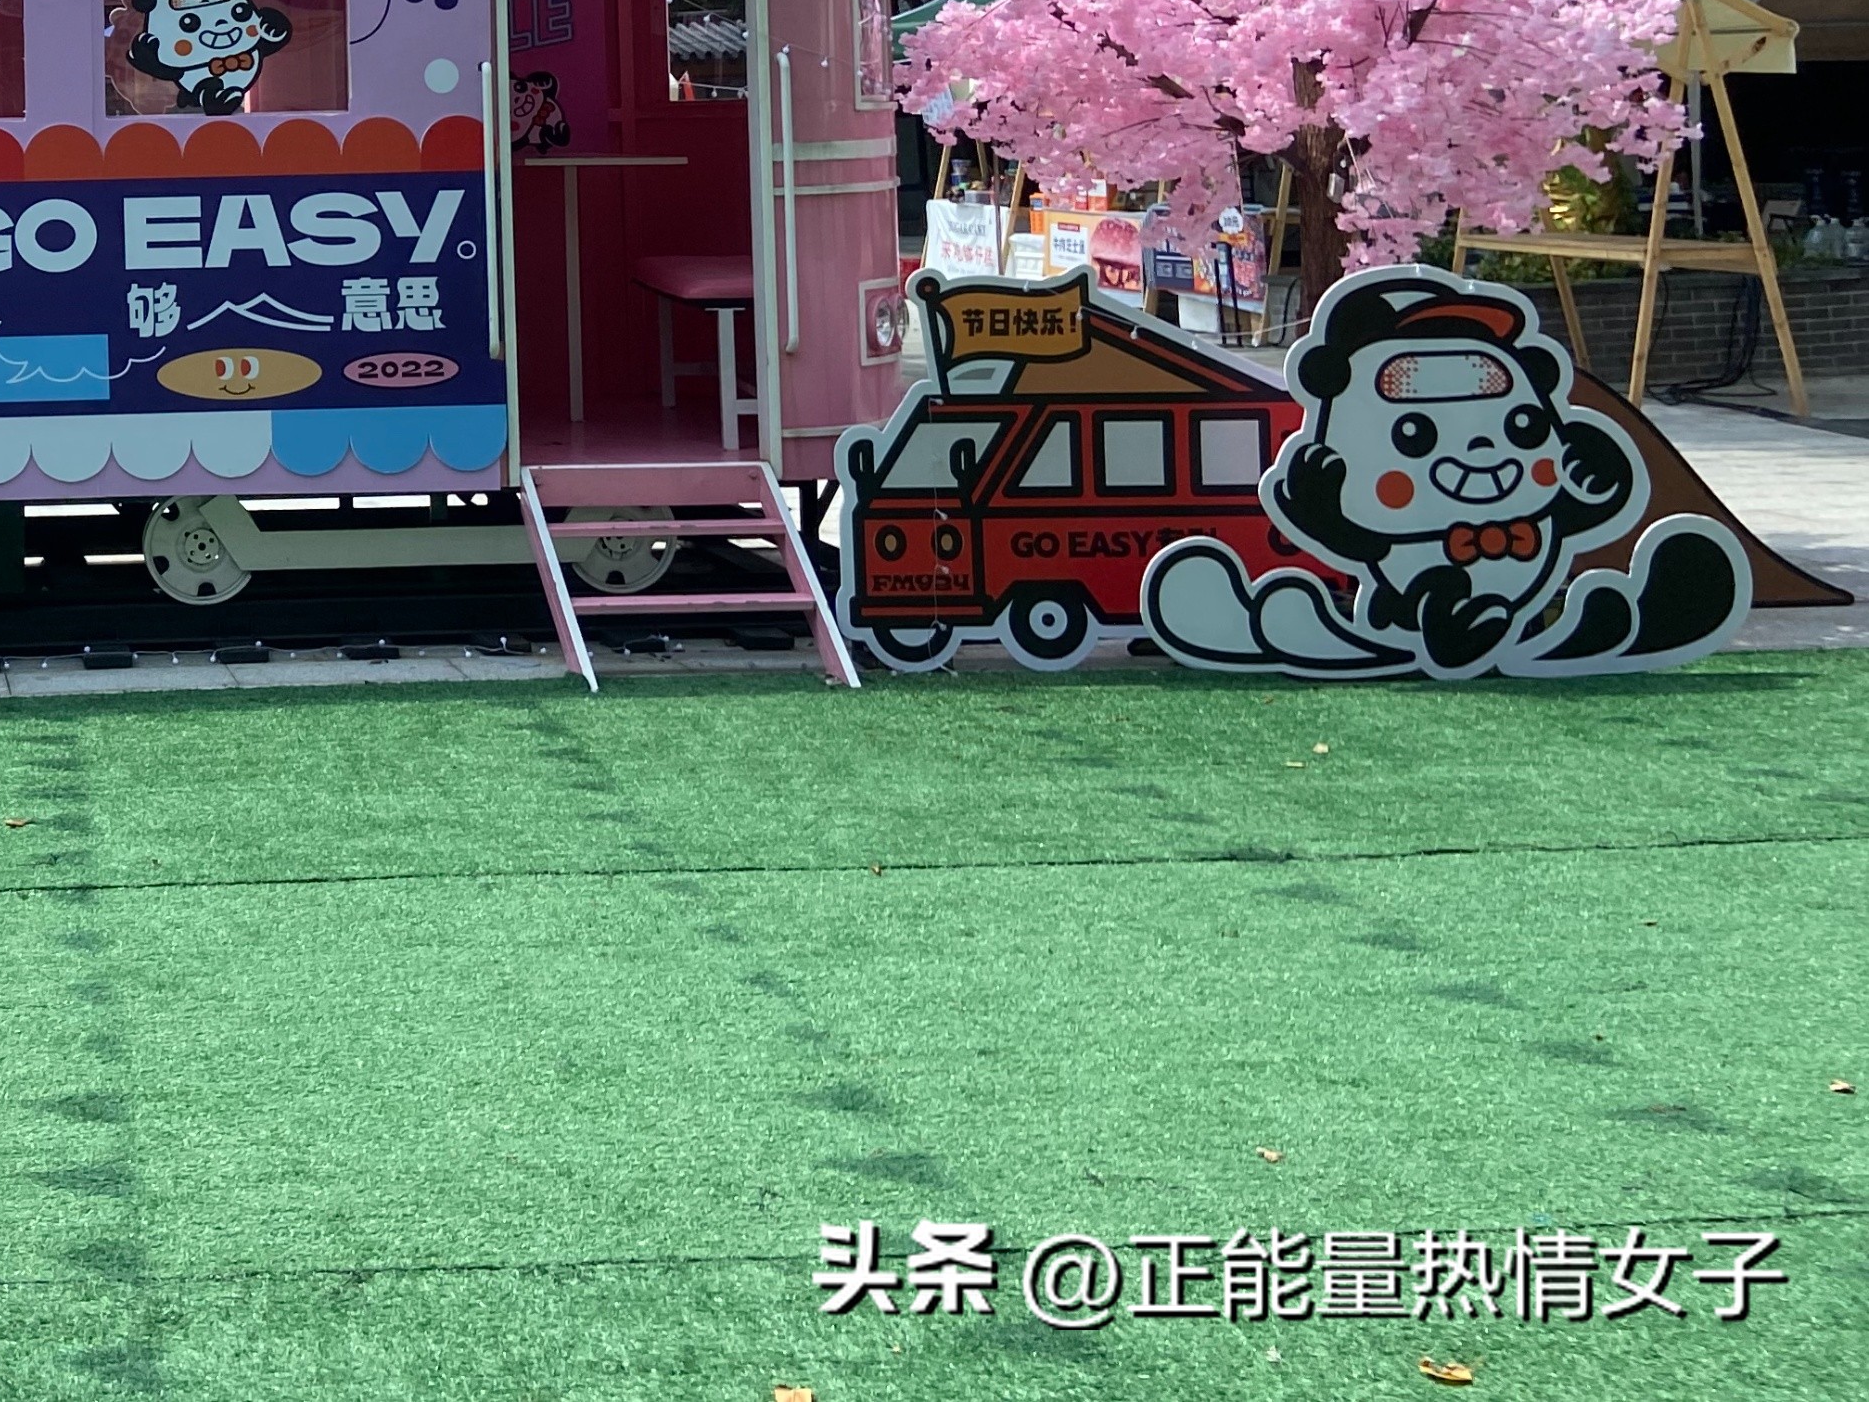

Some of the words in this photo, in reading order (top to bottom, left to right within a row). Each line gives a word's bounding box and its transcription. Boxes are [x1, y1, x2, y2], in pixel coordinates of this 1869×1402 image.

[357, 359, 446, 380] 2022
[1010, 531, 1061, 558] GO
[1067, 530, 1154, 558] EASY
